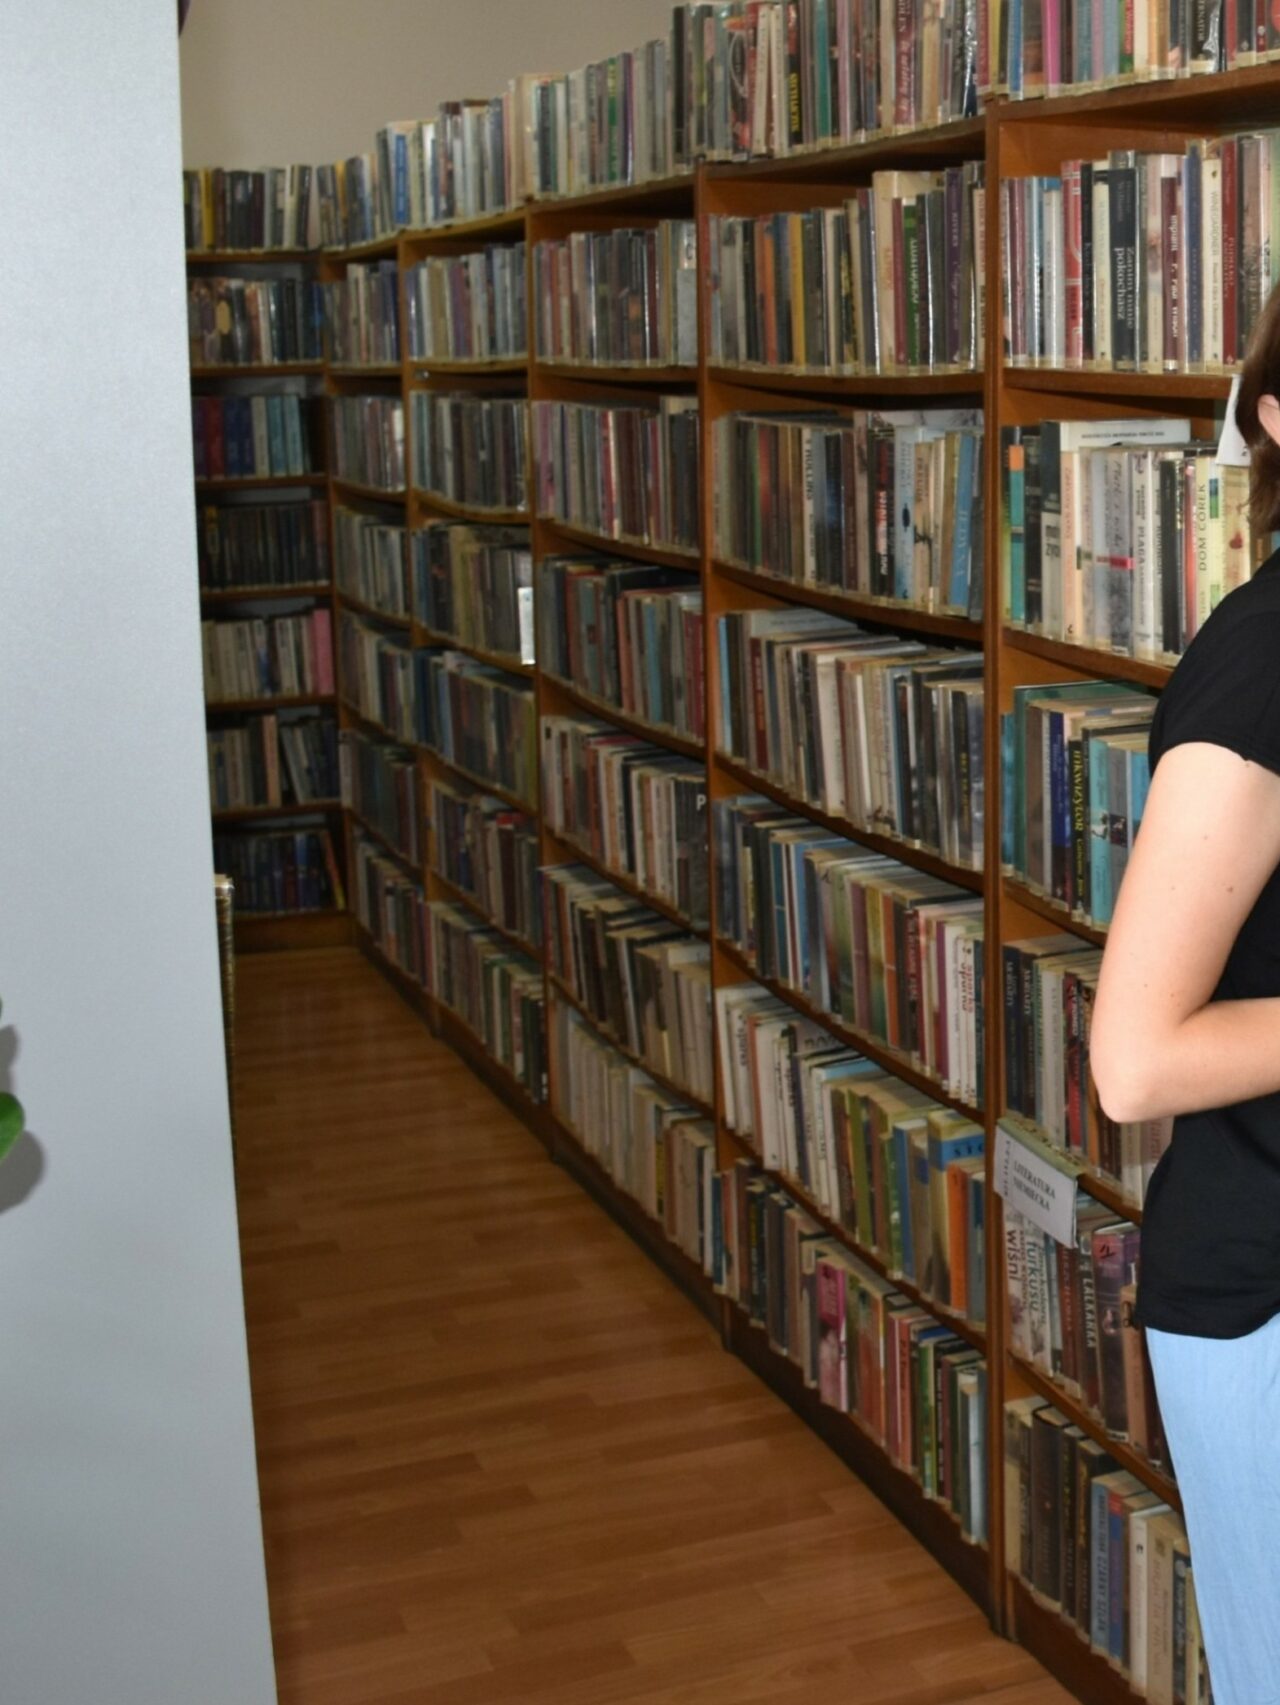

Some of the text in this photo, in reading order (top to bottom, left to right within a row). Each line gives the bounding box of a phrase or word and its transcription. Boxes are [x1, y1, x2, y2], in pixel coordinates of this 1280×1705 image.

[1114, 247, 1126, 320] pokochasz
[1138, 526, 1146, 566] PLAGA
[1199, 536, 1208, 571] DOM
[1014, 1161, 1056, 1199] LITERATURA
[1026, 1241, 1040, 1312] turkusu
